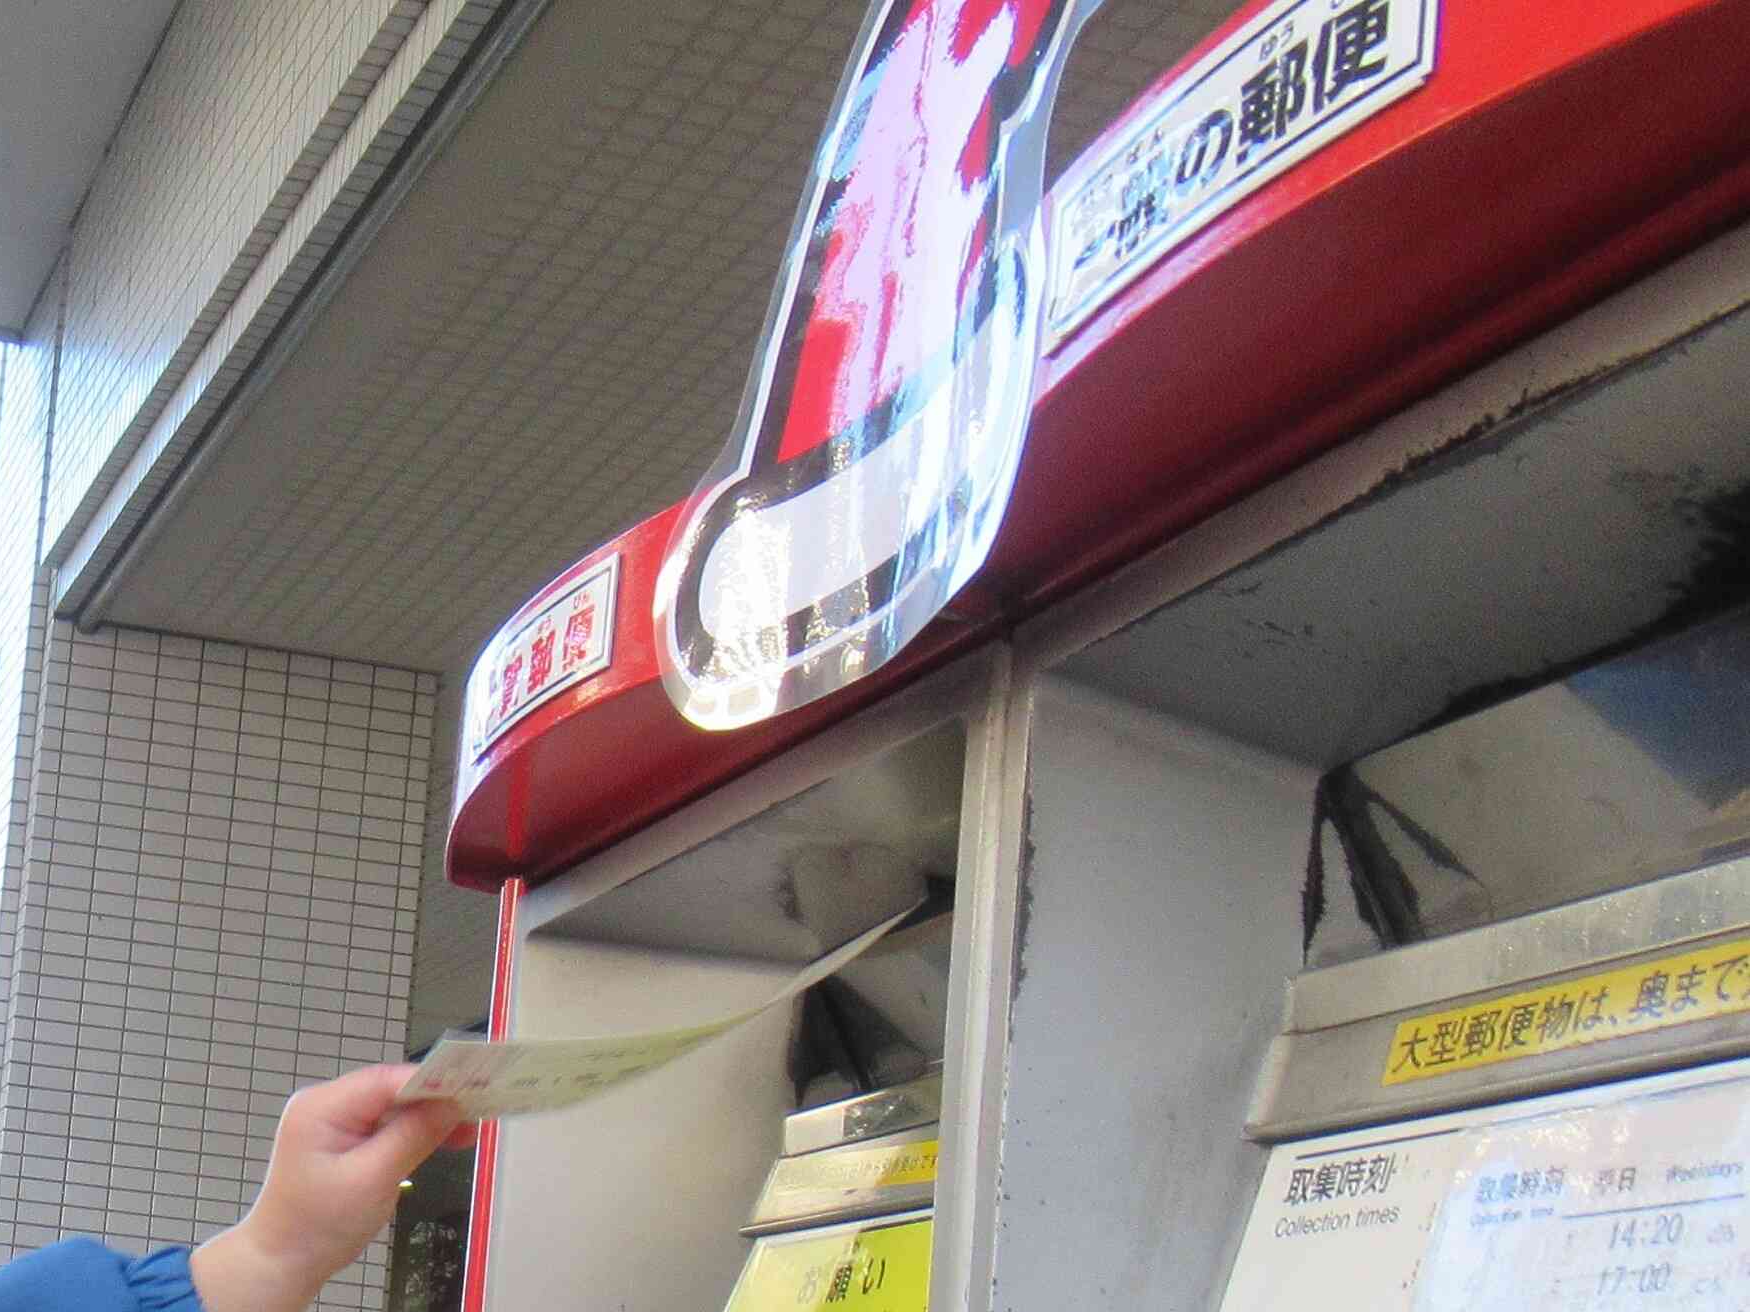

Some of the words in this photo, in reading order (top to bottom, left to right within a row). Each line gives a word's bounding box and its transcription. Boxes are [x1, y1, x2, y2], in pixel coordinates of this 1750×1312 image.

[1073, 0, 1390, 270] の郵便
[1392, 953, 1750, 1073] 大型郵便物は、奥まで
[1284, 1152, 1397, 1206] 取集時刻
[1274, 1209, 1351, 1239] Collection
[1354, 1205, 1401, 1228] times
[1608, 1213, 1685, 1249] 14:20
